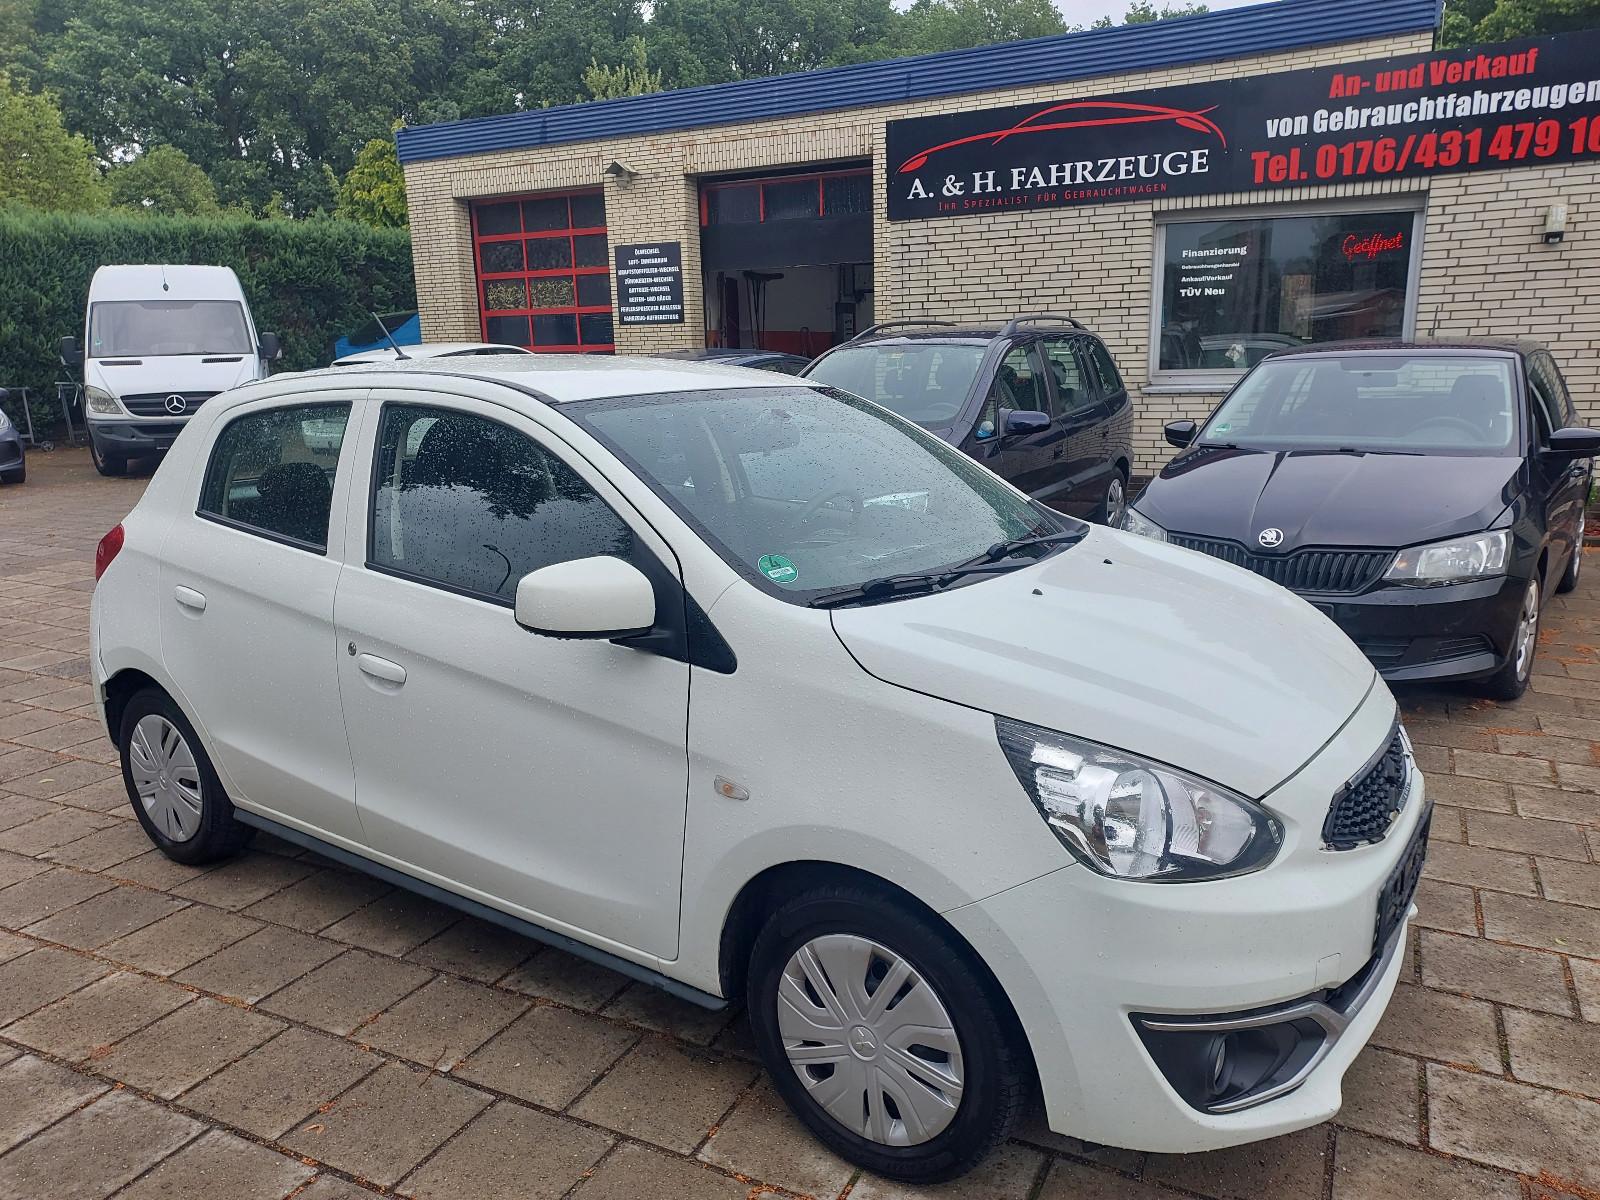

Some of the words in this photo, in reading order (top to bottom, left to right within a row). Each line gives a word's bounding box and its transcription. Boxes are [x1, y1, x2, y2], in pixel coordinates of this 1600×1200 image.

[1328, 73, 1370, 99] An-
[1375, 62, 1425, 93] und
[1429, 48, 1539, 86] Verkauf
[1265, 115, 1309, 139] von
[1312, 79, 1600, 134] Gebrauchtfahrzeugen
[906, 178, 935, 200] A.
[941, 174, 965, 197] &
[971, 170, 1002, 194] H.
[1010, 149, 1209, 190] FAHRZEUGE
[1250, 148, 1309, 184] Tel.
[1487, 119, 1561, 160] 479
[1182, 245, 1249, 258] Finanzierung
[1342, 231, 1403, 261] Geöffnet
[1179, 286, 1202, 297] TÜV
[1204, 287, 1225, 296] Neu
